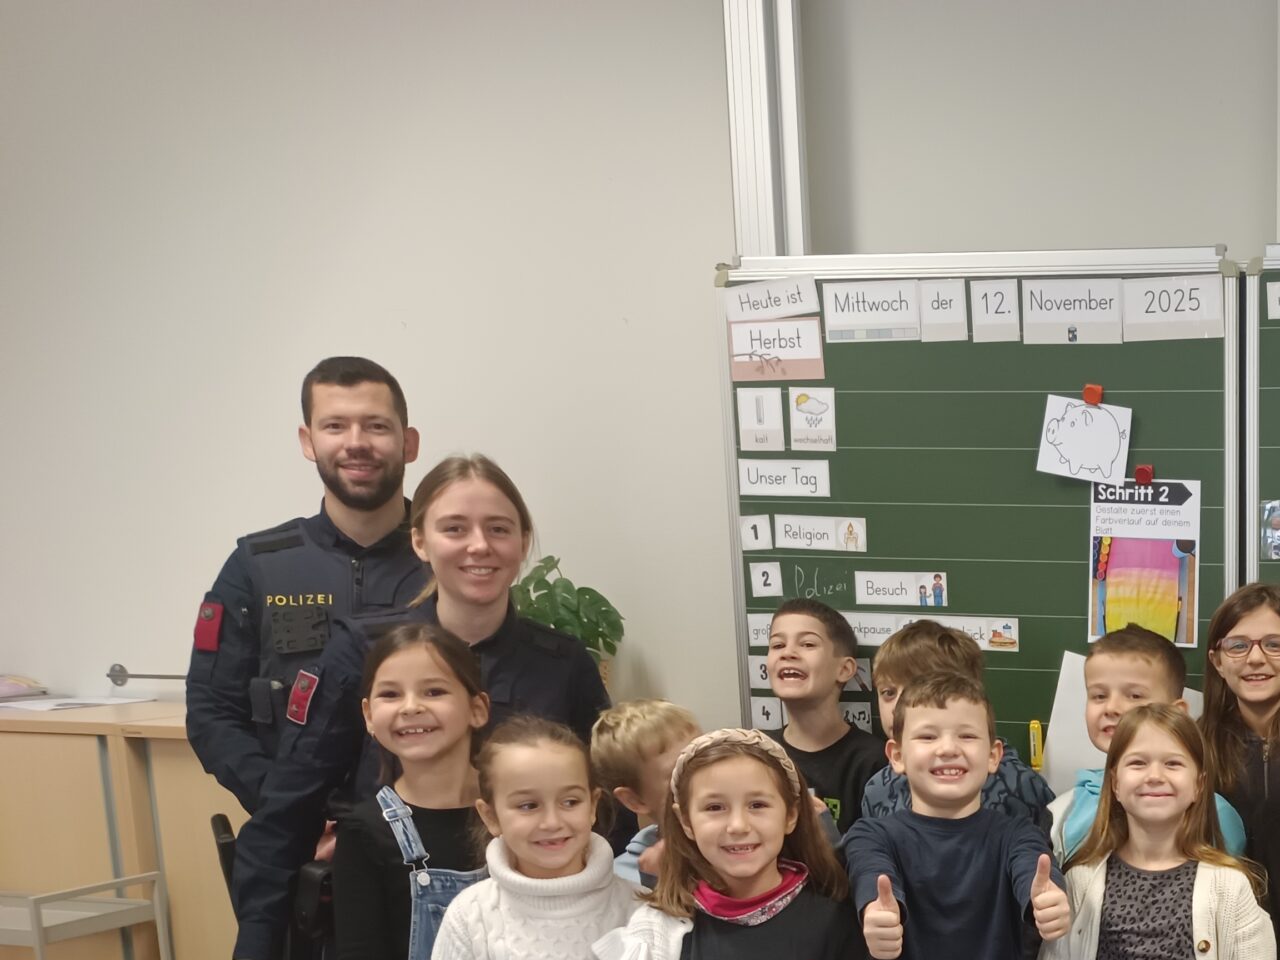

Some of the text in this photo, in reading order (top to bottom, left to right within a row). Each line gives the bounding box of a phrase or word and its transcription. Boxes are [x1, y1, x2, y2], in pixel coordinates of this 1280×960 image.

[738, 285, 803, 313] Heute ist
[833, 290, 909, 313] Mittwoch
[930, 291, 953, 311] der
[981, 291, 1011, 315] 12.
[1029, 288, 1114, 311] November
[1144, 287, 1201, 314] 2025
[749, 328, 802, 351] Herbst
[755, 433, 769, 444] kalt
[747, 467, 818, 493] Unser Tag
[1098, 484, 1169, 502] Schritt 2
[1095, 505, 1181, 517] Gestalte zuerst einen
[1095, 515, 1191, 528] Farbverlauf auf deinem
[1095, 525, 1113, 536] Blatt
[750, 523, 759, 540] 1
[784, 524, 829, 547] Religion
[761, 570, 772, 587] 2
[793, 564, 848, 599] Polizei
[866, 579, 908, 597] Besuch
[266, 593, 333, 607] POLIZEI
[752, 623, 771, 640] groß
[852, 620, 892, 639] nkpause
[760, 663, 768, 680] 3
[762, 705, 771, 721] 4
